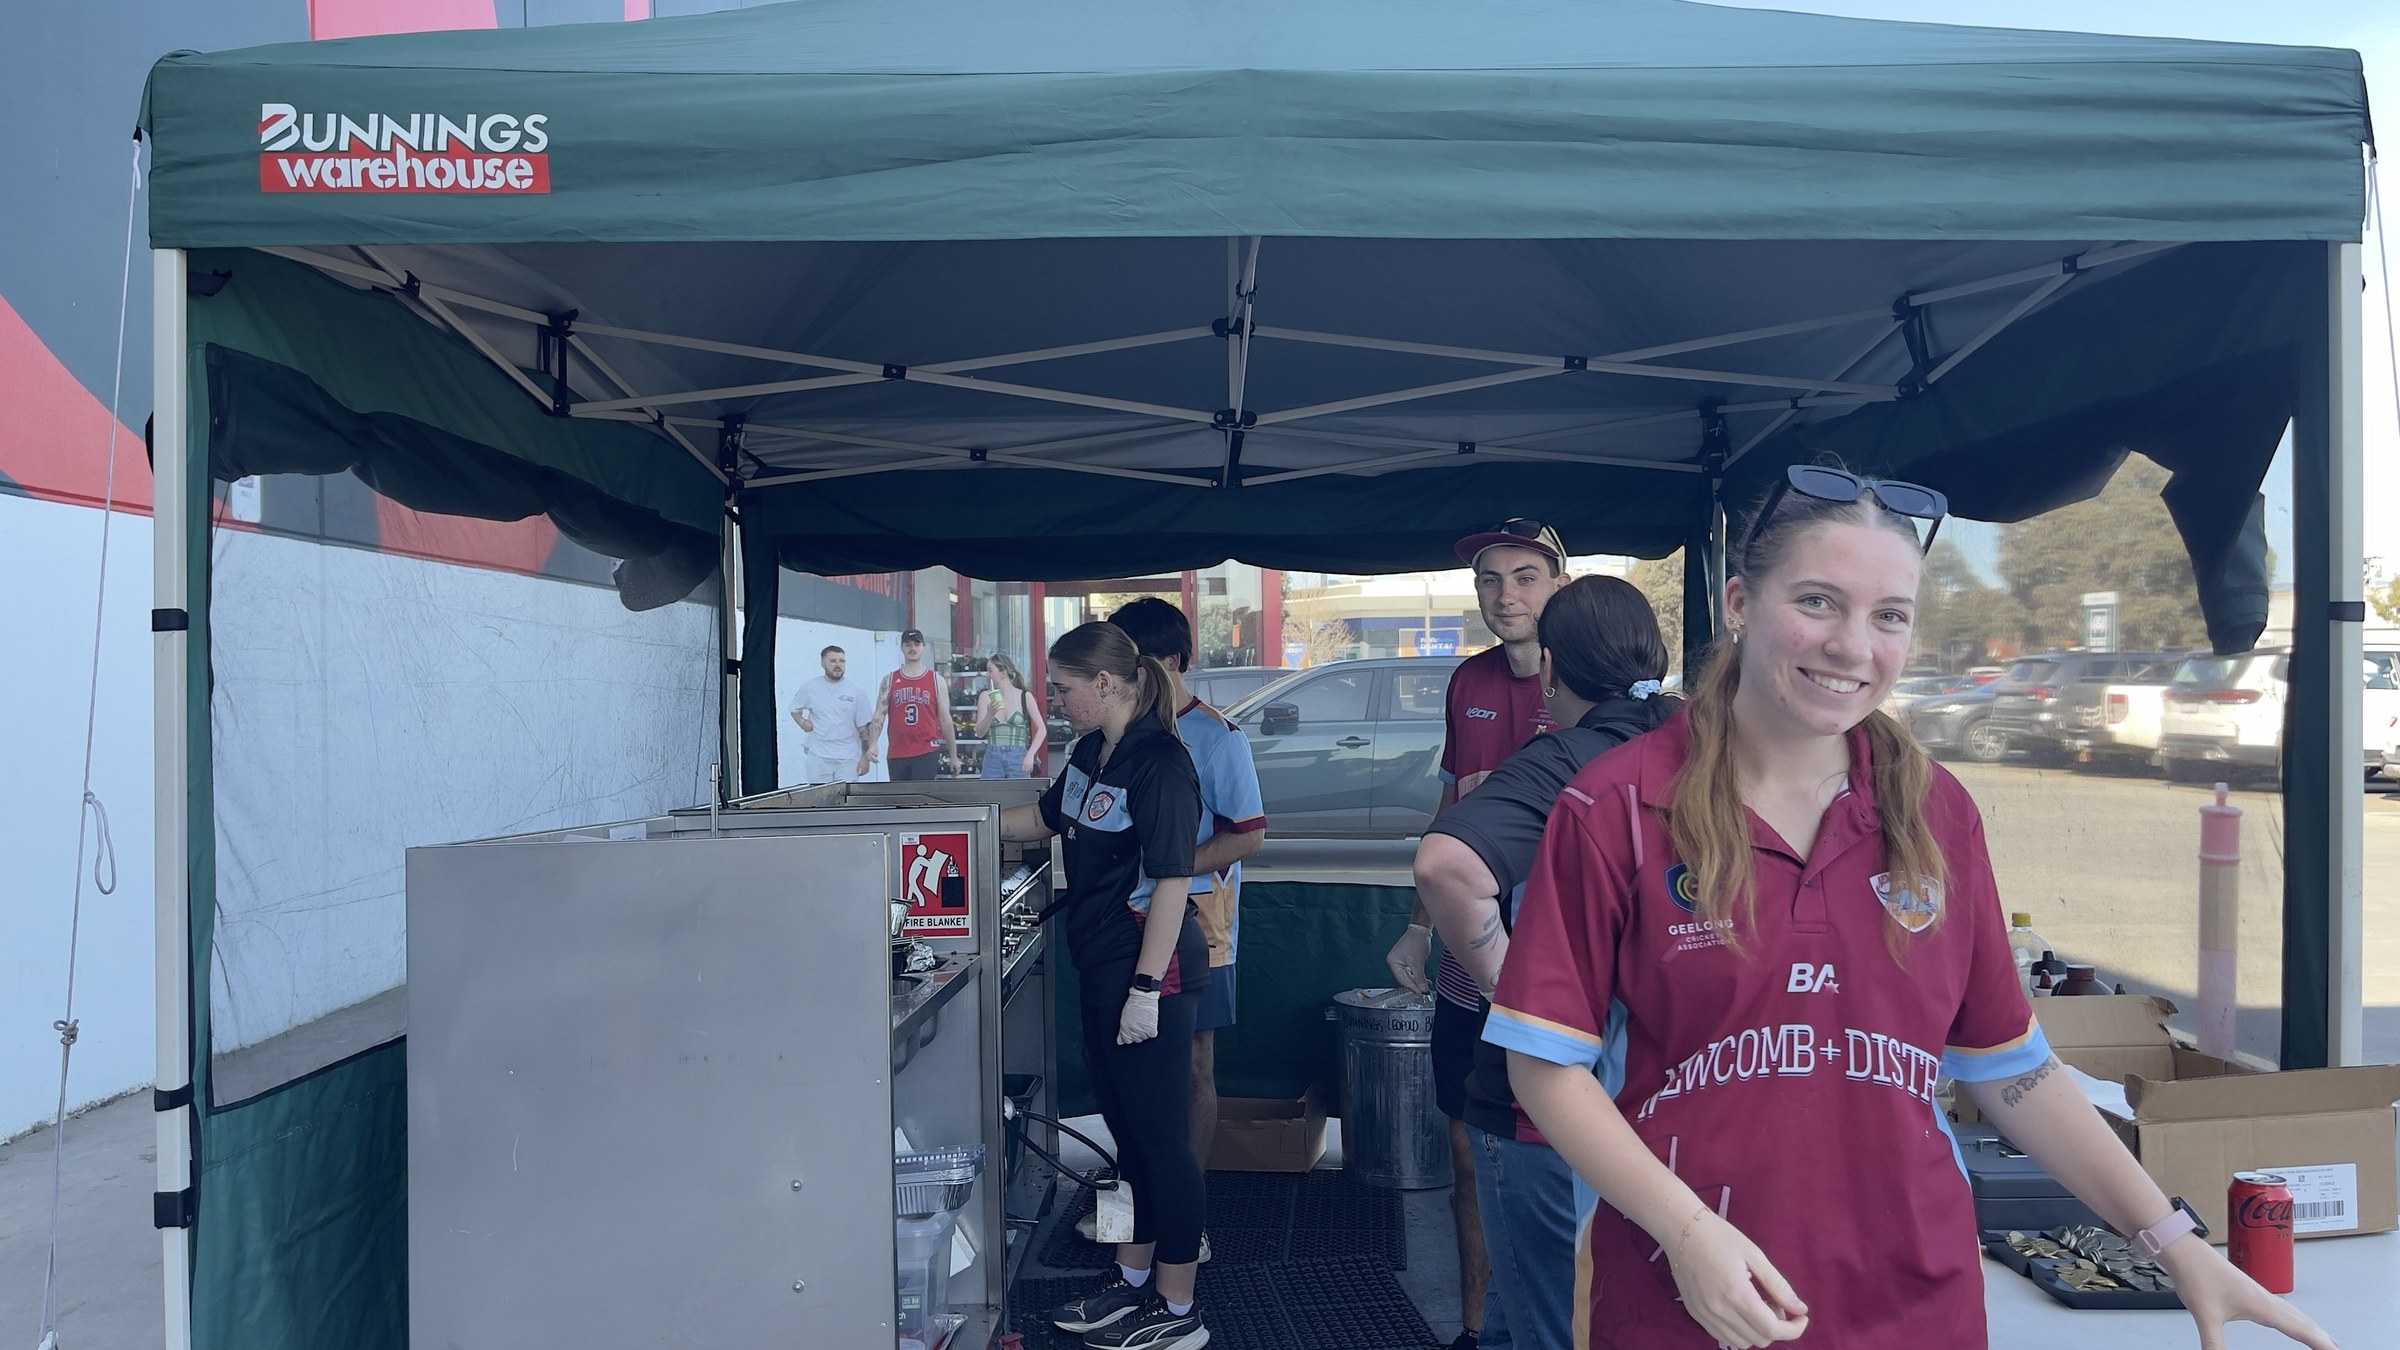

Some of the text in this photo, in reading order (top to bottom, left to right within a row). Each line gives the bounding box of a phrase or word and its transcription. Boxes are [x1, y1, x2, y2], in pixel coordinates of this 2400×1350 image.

[259, 103, 549, 153] BUNNINGS
[277, 142, 534, 189] warehouse
[894, 686, 930, 707] BULLS
[905, 704, 918, 726] 3
[905, 917, 967, 927] FIRE BLANKET
[1668, 919, 1734, 936] GEELONG
[1677, 939, 1730, 951] ASSOCIATIO
[1387, 1017, 1419, 1032] LEOPOLD
